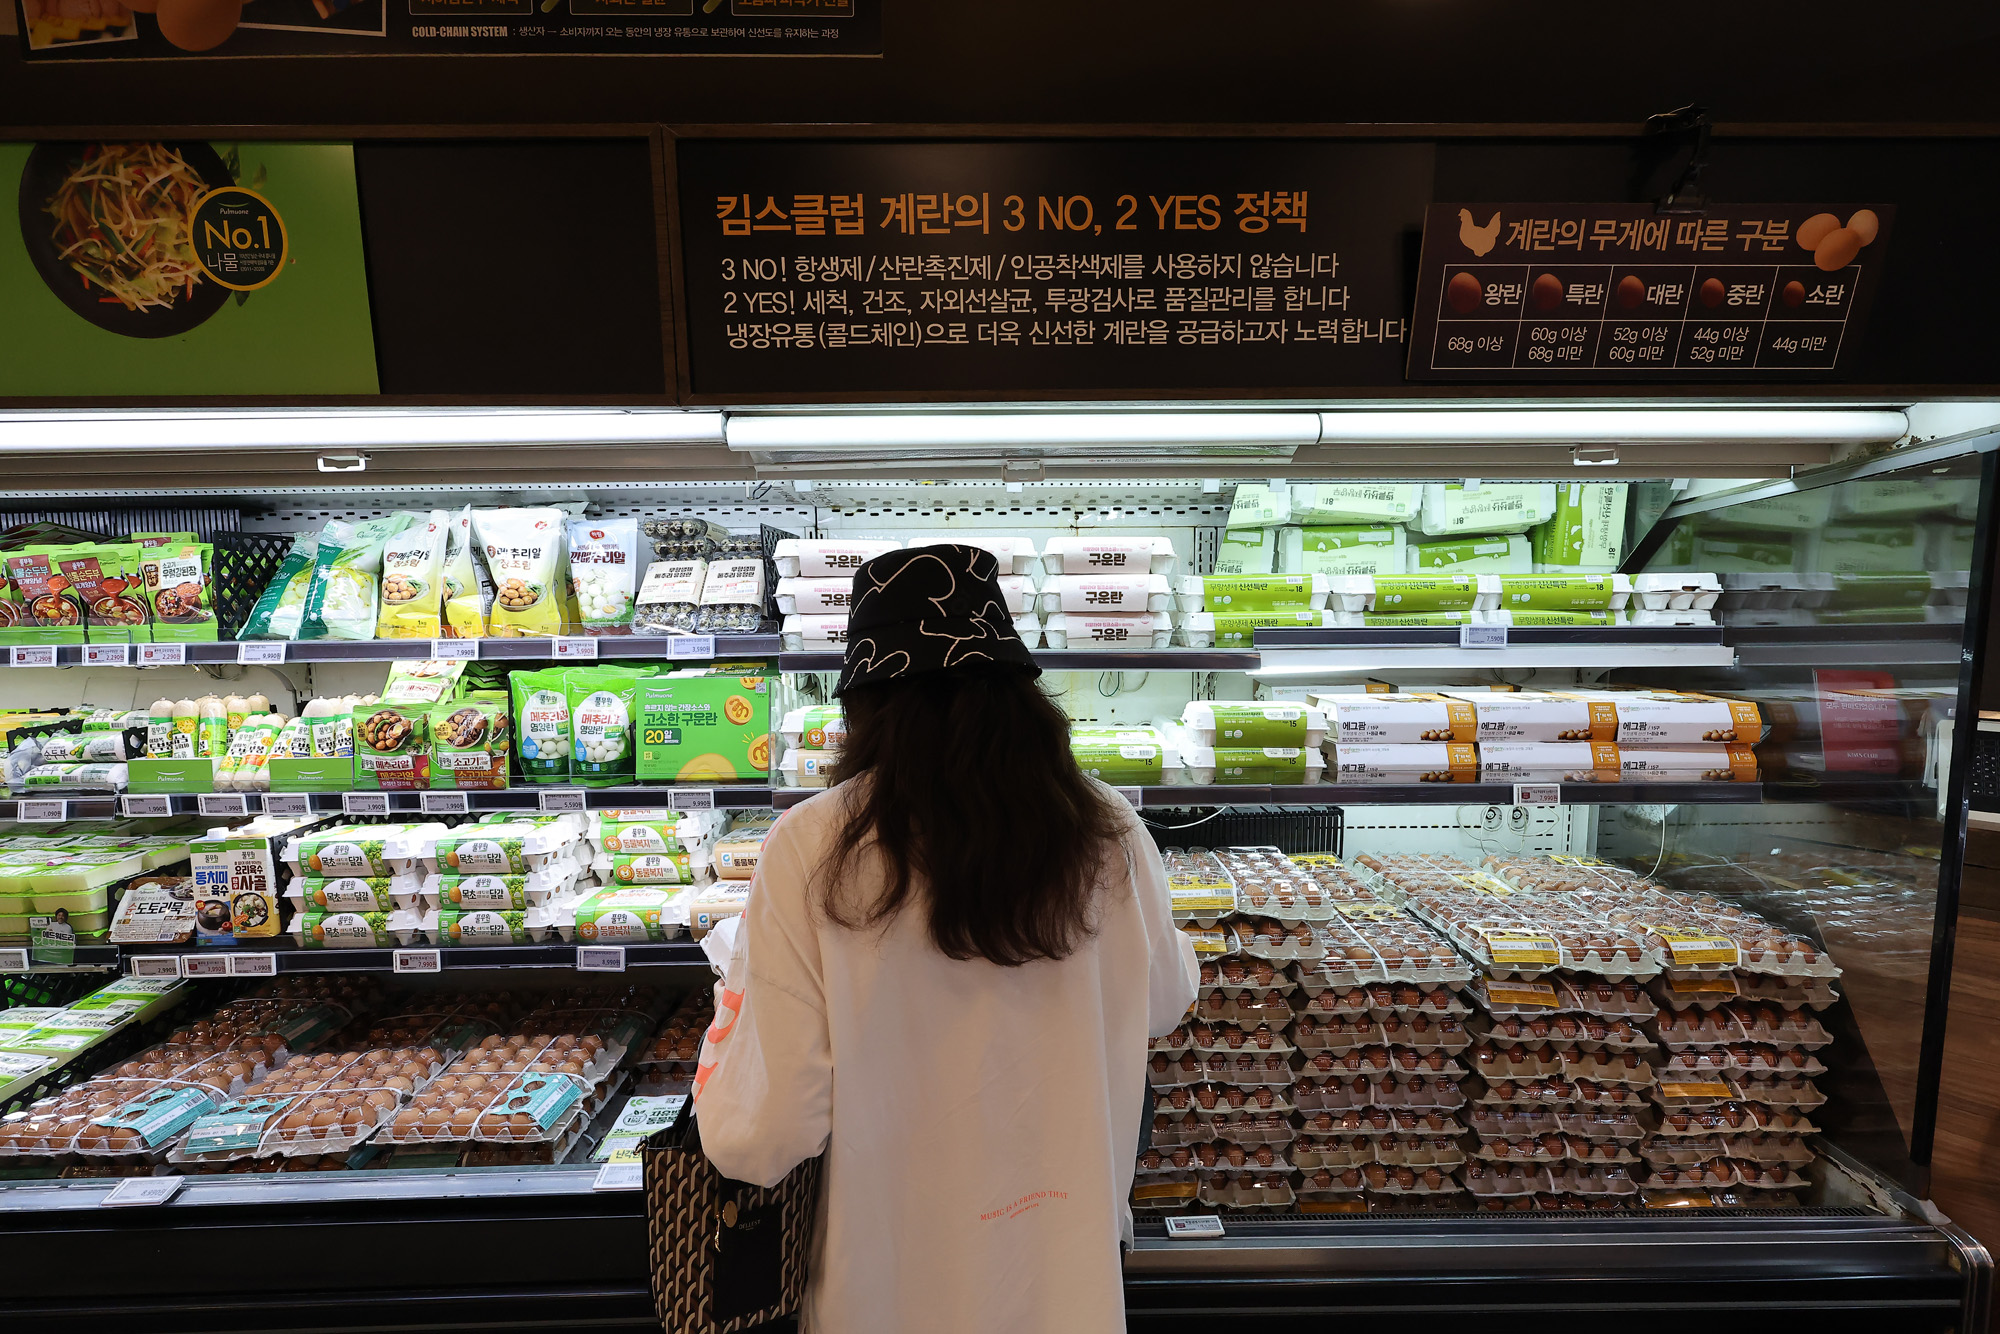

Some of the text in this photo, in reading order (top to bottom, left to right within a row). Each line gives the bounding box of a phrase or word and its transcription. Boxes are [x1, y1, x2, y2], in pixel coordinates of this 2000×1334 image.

[412, 26, 507, 37] COLD-CHAIN SYSTEM
[519, 27, 838, 38] 생산자 소비자까지 오는 동안의 냉장 유통으로 보관하여 신선도를 유지하는 과정
[717, 191, 1307, 236] 킴스클럽 계란의 3 NO, 2 YES 정책
[204, 215, 270, 250] No.1
[1506, 219, 1789, 251] 계란의 무게에 따른 구분
[206, 252, 239, 272] 나물
[722, 259, 735, 280] 3
[743, 257, 786, 281] NO!
[1152, 254, 1241, 279] 사용하지
[1250, 253, 1339, 278] 않습니다
[724, 286, 1350, 316] 2 YES! 세척, 건조, 자외선살균, 투광검사로 품질관리를 합니다
[1485, 284, 1523, 306] 왕란
[1566, 284, 1603, 305] 특란
[1647, 284, 1683, 305] 대란
[1727, 284, 1764, 305] 중란
[1806, 285, 1844, 305] 소란
[727, 319, 1406, 349] 냉장유통(콜드체인)으로 더욱 신선한 계란을 공급하고자 노력합니다
[1532, 327, 1587, 343] 60g 이상
[1614, 327, 1668, 343] 52g 이상
[1694, 327, 1749, 343] 44g 이상
[1448, 336, 1503, 353] 68g 이상
[1773, 337, 1827, 353] 44g 미만
[1529, 346, 1583, 362] 68g 미만
[1610, 346, 1664, 362] 60g 미만
[1690, 346, 1744, 362] 52g 미만
[824, 554, 863, 568] 구운란
[1088, 552, 1127, 566] 구운란
[1295, 585, 1303, 593] 18
[1462, 584, 1470, 592] 18
[1596, 583, 1605, 591] 18
[1085, 591, 1124, 605] 구운란
[1091, 628, 1129, 641] 구운란
[644, 703, 711, 712] 흐르지 않는 간장소스와
[643, 712, 718, 727] 고소한 구운란
[1288, 720, 1298, 728] 15
[1342, 721, 1367, 731] 에그팜
[1480, 722, 1506, 731] 에그팜
[1622, 722, 1647, 731] 에그팜
[453, 757, 480, 766] 소고기
[1144, 758, 1153, 766] 15
[1288, 757, 1297, 765] 15
[1485, 762, 1510, 771] 에그팜
[1622, 761, 1647, 770] 에그팜
[1341, 764, 1366, 773] 에그팜
[622, 839, 651, 848] 동물복지
[348, 856, 364, 867] 달걀
[487, 853, 502, 864] 달걀
[234, 865, 264, 875] 요리육수
[635, 868, 664, 878] 동물복지
[195, 870, 229, 885] 동치미
[239, 875, 267, 891] 사골
[211, 884, 229, 897] 육수
[354, 891, 370, 902] 달걀
[489, 888, 504, 900] 달걀
[135, 901, 184, 915] 도토리묵
[352, 927, 367, 938] 달걀
[489, 924, 504, 936] 달걀
[600, 926, 631, 936] 동물복지
[980, 1208, 1005, 1221] MUSIC
[1005, 1204, 1013, 1213] IS
[1019, 1191, 1047, 1205] FRIEND
[1047, 1190, 1069, 1200] THAT
